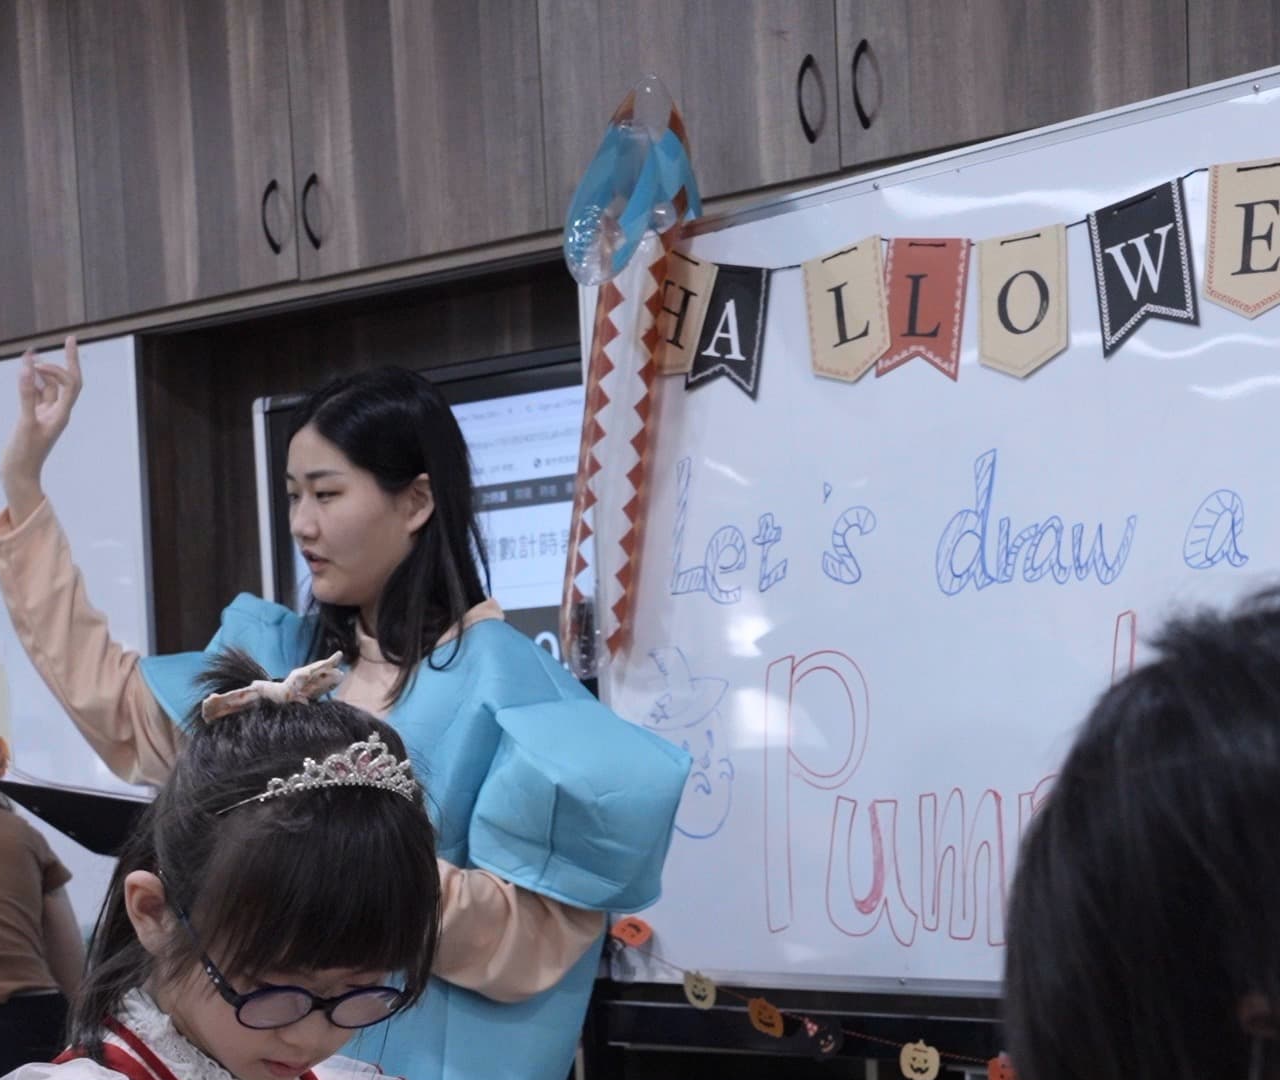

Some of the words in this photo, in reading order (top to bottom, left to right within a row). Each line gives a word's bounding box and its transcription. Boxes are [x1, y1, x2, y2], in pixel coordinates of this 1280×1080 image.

[669, 456, 878, 605] Let's
[935, 447, 1138, 597] draw
[1182, 488, 1250, 571] a
